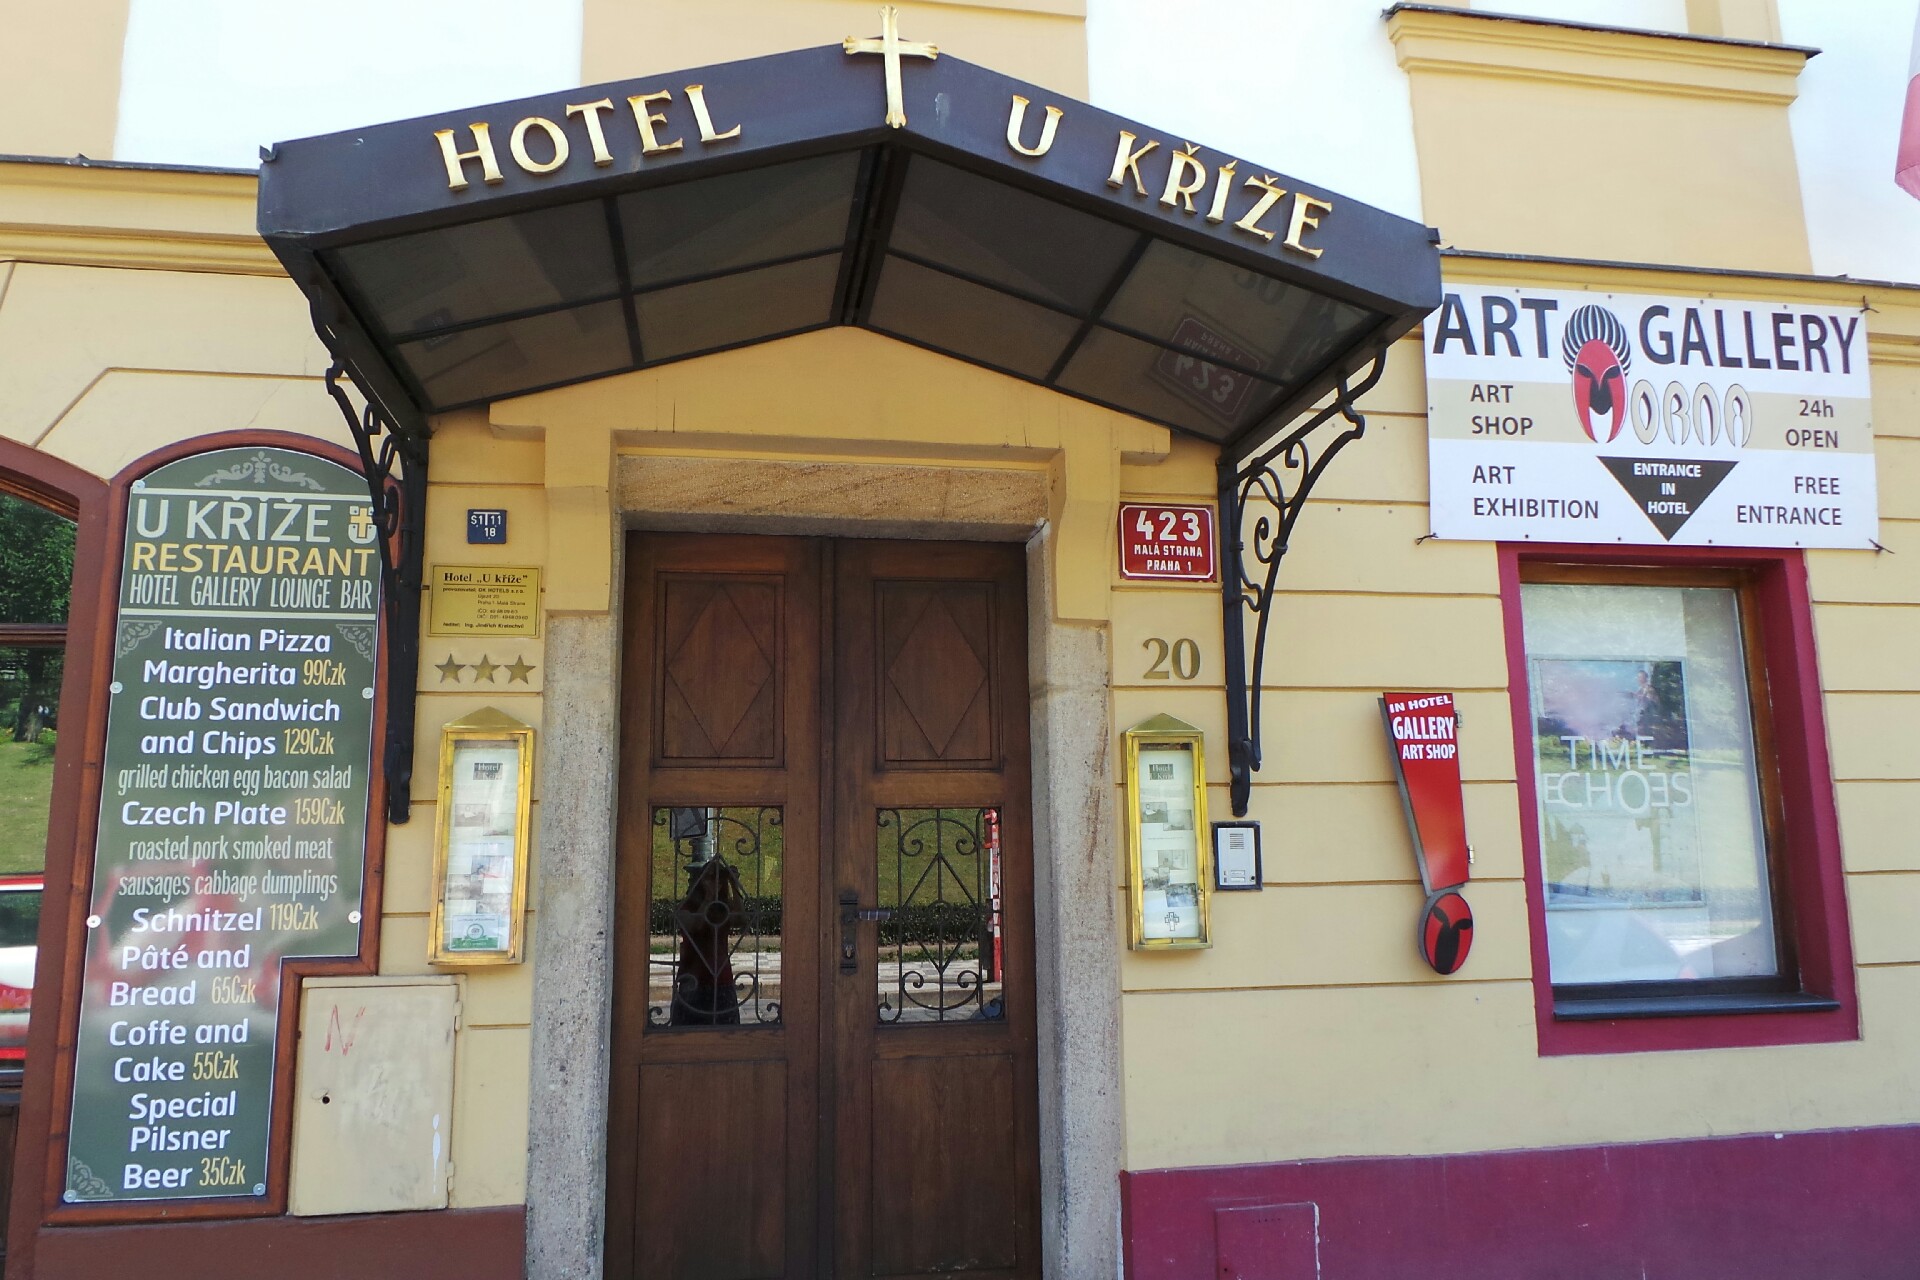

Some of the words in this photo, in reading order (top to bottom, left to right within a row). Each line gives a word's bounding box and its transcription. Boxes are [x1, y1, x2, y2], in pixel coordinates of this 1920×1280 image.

[434, 84, 741, 190] HOTEL
[1006, 94, 1063, 157] U
[1107, 130, 1333, 260] KŘÍŽE
[1432, 292, 1558, 359] ART
[1639, 304, 1858, 375] GALLERY
[1470, 384, 1514, 403] ART
[1799, 400, 1834, 418] 24h
[1471, 415, 1533, 436] SHOP
[1785, 428, 1839, 449] OPEN
[1472, 465, 1515, 484] ART
[1633, 462, 1702, 478] ENTRANCE
[1661, 483, 1675, 496] IN
[1794, 476, 1841, 495] FREE
[136, 498, 169, 538] U
[1473, 497, 1599, 519] EXHIBITION
[1648, 502, 1690, 515] HOTEL
[1736, 504, 1843, 526] ENTRANCE
[1136, 510, 1201, 542] 423
[132, 542, 376, 577] RESTAURANT
[1134, 542, 1160, 556] MALÁ
[1163, 545, 1203, 558] STRANA
[444, 572, 472, 583] Hotel
[1147, 559, 1180, 571] PRAHA
[1187, 561, 1192, 571] 1
[129, 574, 179, 605] HOTEL
[190, 575, 262, 608] GALLERY
[270, 578, 331, 609] LOUNGE
[340, 579, 373, 610] BAR
[164, 627, 251, 651] Italian
[259, 629, 330, 653] Pizza
[1142, 637, 1201, 680] 20
[143, 659, 296, 690] Margherita
[303, 659, 346, 686] 99Czk
[140, 696, 201, 720] Club
[208, 697, 340, 722] Sandwich
[1389, 702, 1405, 713] IN
[1408, 695, 1452, 710] HOTEL
[1392, 716, 1454, 740] GALLERY
[141, 730, 194, 754] and
[202, 731, 276, 760] Chips
[284, 728, 335, 755] 129Czk
[1402, 744, 1424, 760] ART
[1425, 744, 1456, 759] SHOP
[1560, 735, 1657, 771] TIME
[118, 764, 168, 796] grilled
[171, 764, 229, 789] chicken
[233, 768, 260, 796] egg
[264, 765, 308, 789] bacon
[312, 765, 352, 789] salad
[121, 801, 206, 825] Czech
[214, 801, 287, 825] Plate
[295, 798, 345, 825] 159Czk
[129, 835, 189, 860] roasted
[192, 835, 229, 867] pork
[232, 835, 291, 860] smoked
[294, 838, 333, 860] meat
[118, 873, 191, 903] sausages
[194, 870, 257, 902] cabbage
[261, 870, 338, 902] dumplings
[131, 907, 262, 932] Schnitzel
[269, 902, 319, 931] 119Czk
[122, 944, 189, 970] Pâté
[197, 944, 251, 969] and
[110, 980, 196, 1006] Bread
[211, 975, 256, 1004] 65Czk
[109, 1020, 187, 1046] Coffe
[195, 1018, 249, 1044] and
[114, 1056, 185, 1082] Cake
[193, 1051, 239, 1080] 55Czk
[129, 1090, 236, 1125] Special
[130, 1125, 231, 1152] Pilsner
[124, 1163, 193, 1189] Beer
[199, 1156, 246, 1186] 35Czk
